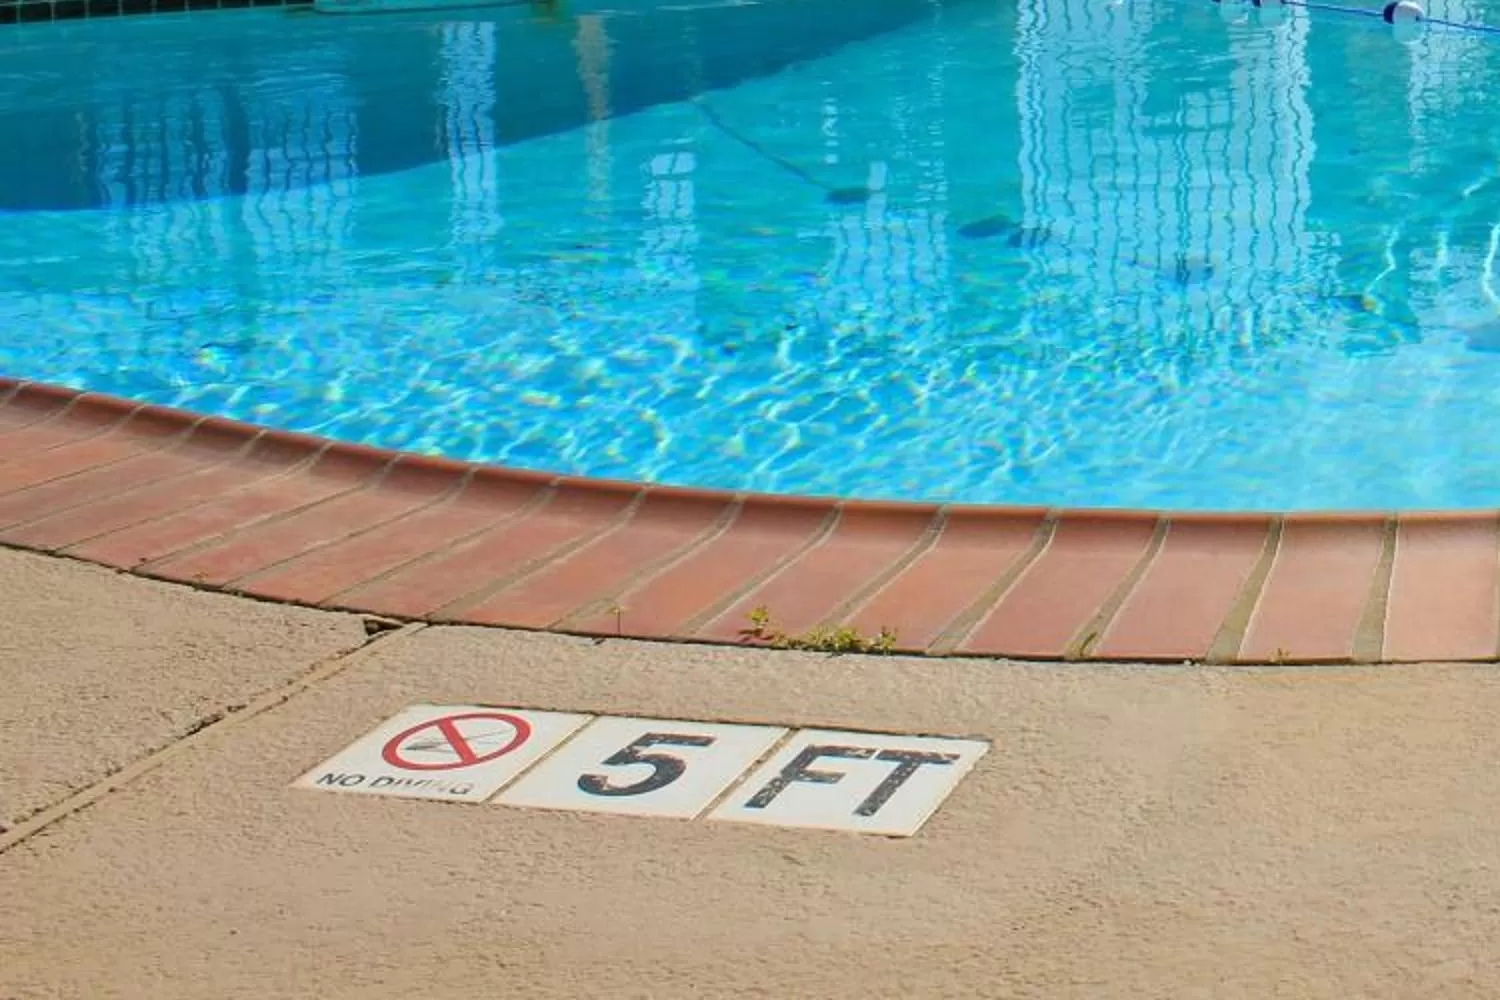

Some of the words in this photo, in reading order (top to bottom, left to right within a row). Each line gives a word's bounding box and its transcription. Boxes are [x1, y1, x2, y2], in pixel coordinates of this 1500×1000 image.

[315, 773, 365, 788] NO
[575, 731, 717, 797] 5
[743, 743, 961, 817] FT
